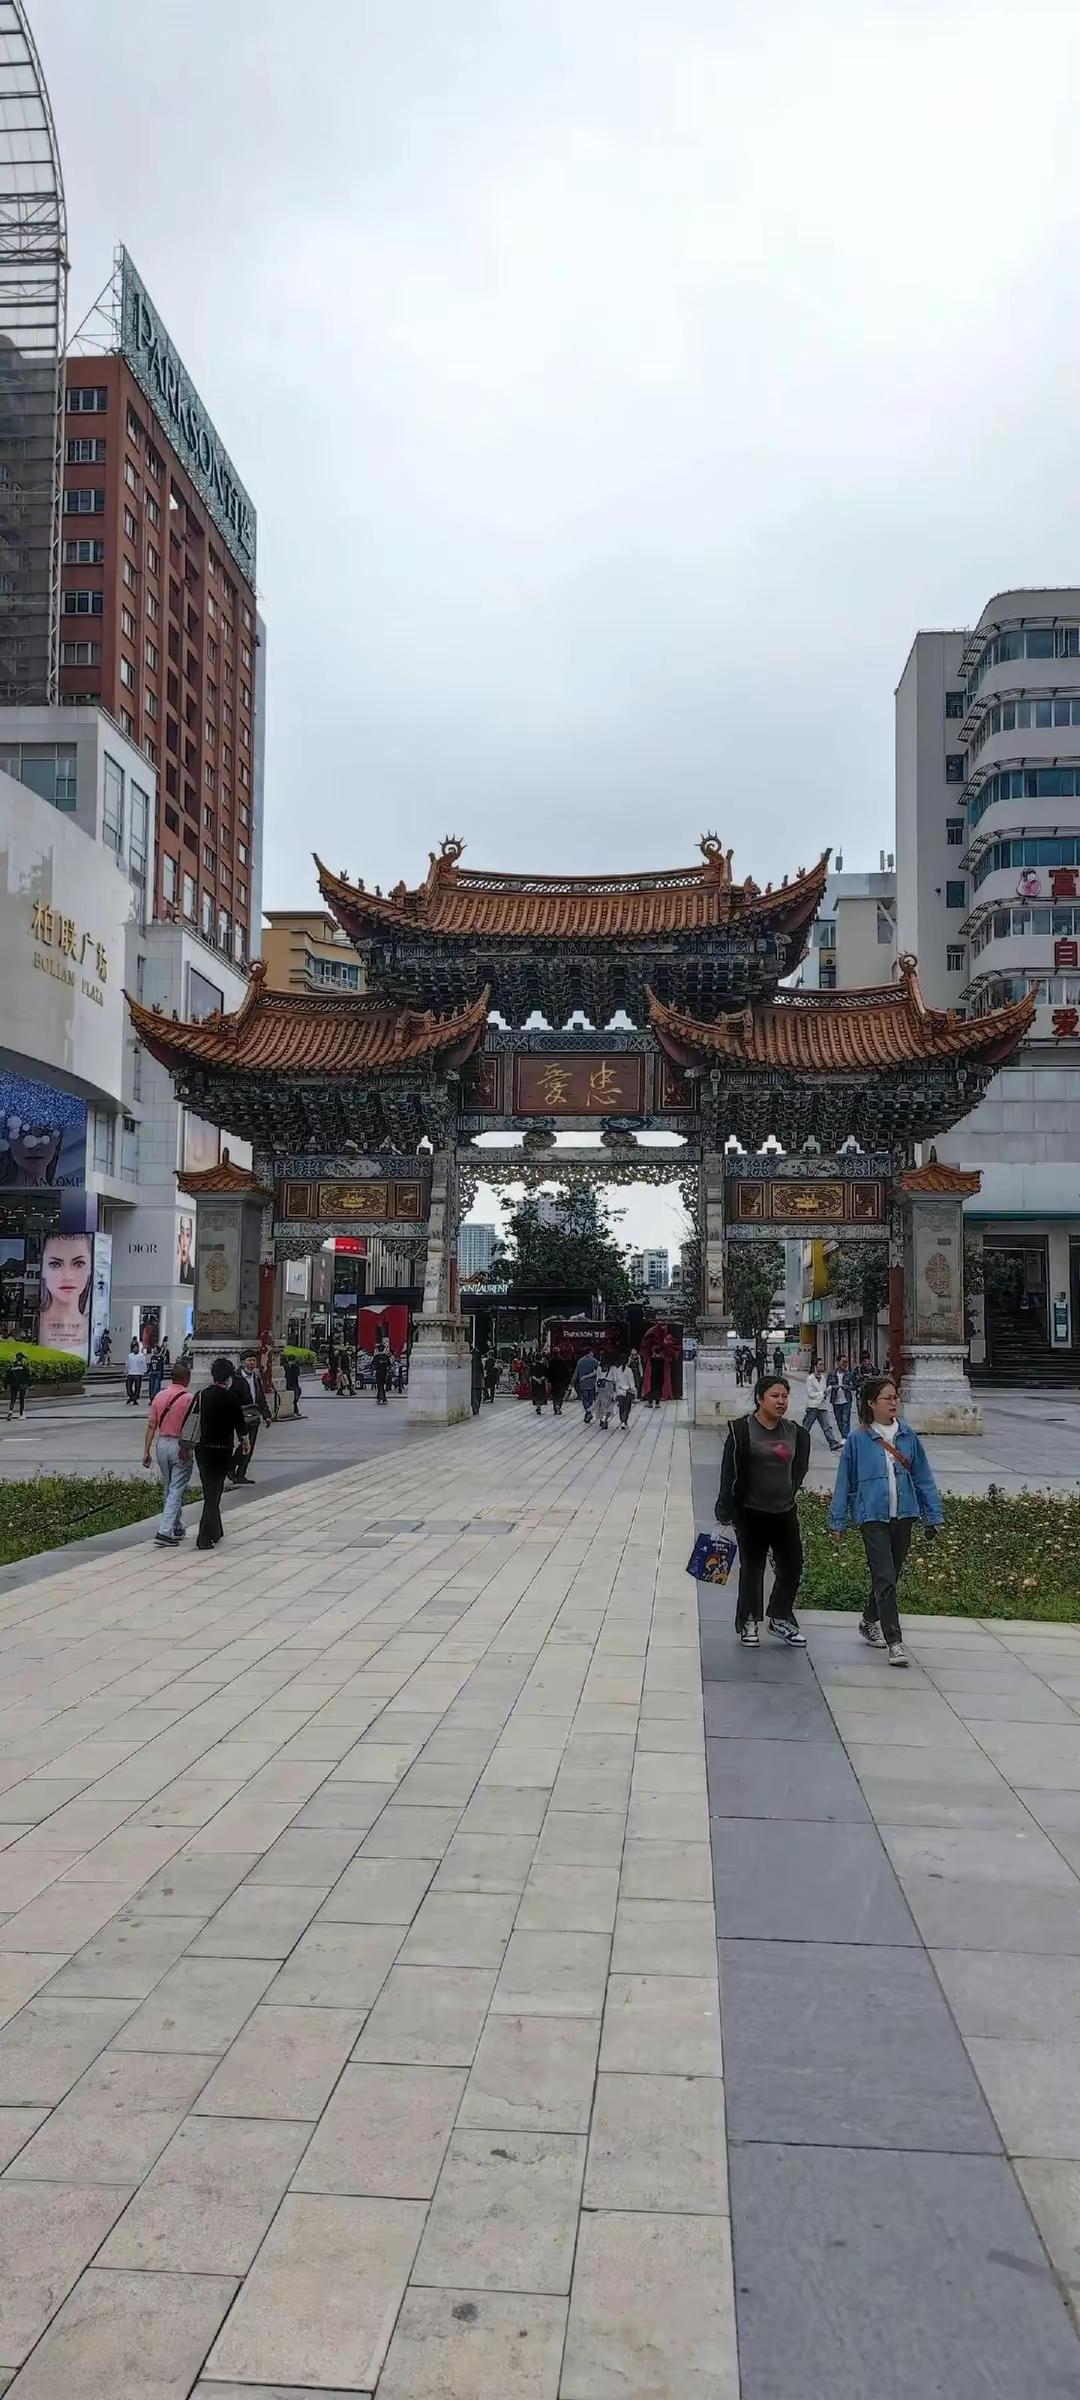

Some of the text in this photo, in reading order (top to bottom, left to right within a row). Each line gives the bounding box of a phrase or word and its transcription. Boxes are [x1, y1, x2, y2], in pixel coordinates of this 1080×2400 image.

[132, 294, 223, 506] PARKSON
[1049, 868, 1079, 897] 富
[31, 900, 108, 984] 柏联广场
[1054, 937, 1078, 967] 自
[80, 976, 104, 1007] PLAZA
[1052, 1008, 1079, 1037] 爱
[128, 1243, 158, 1254] DIOR
